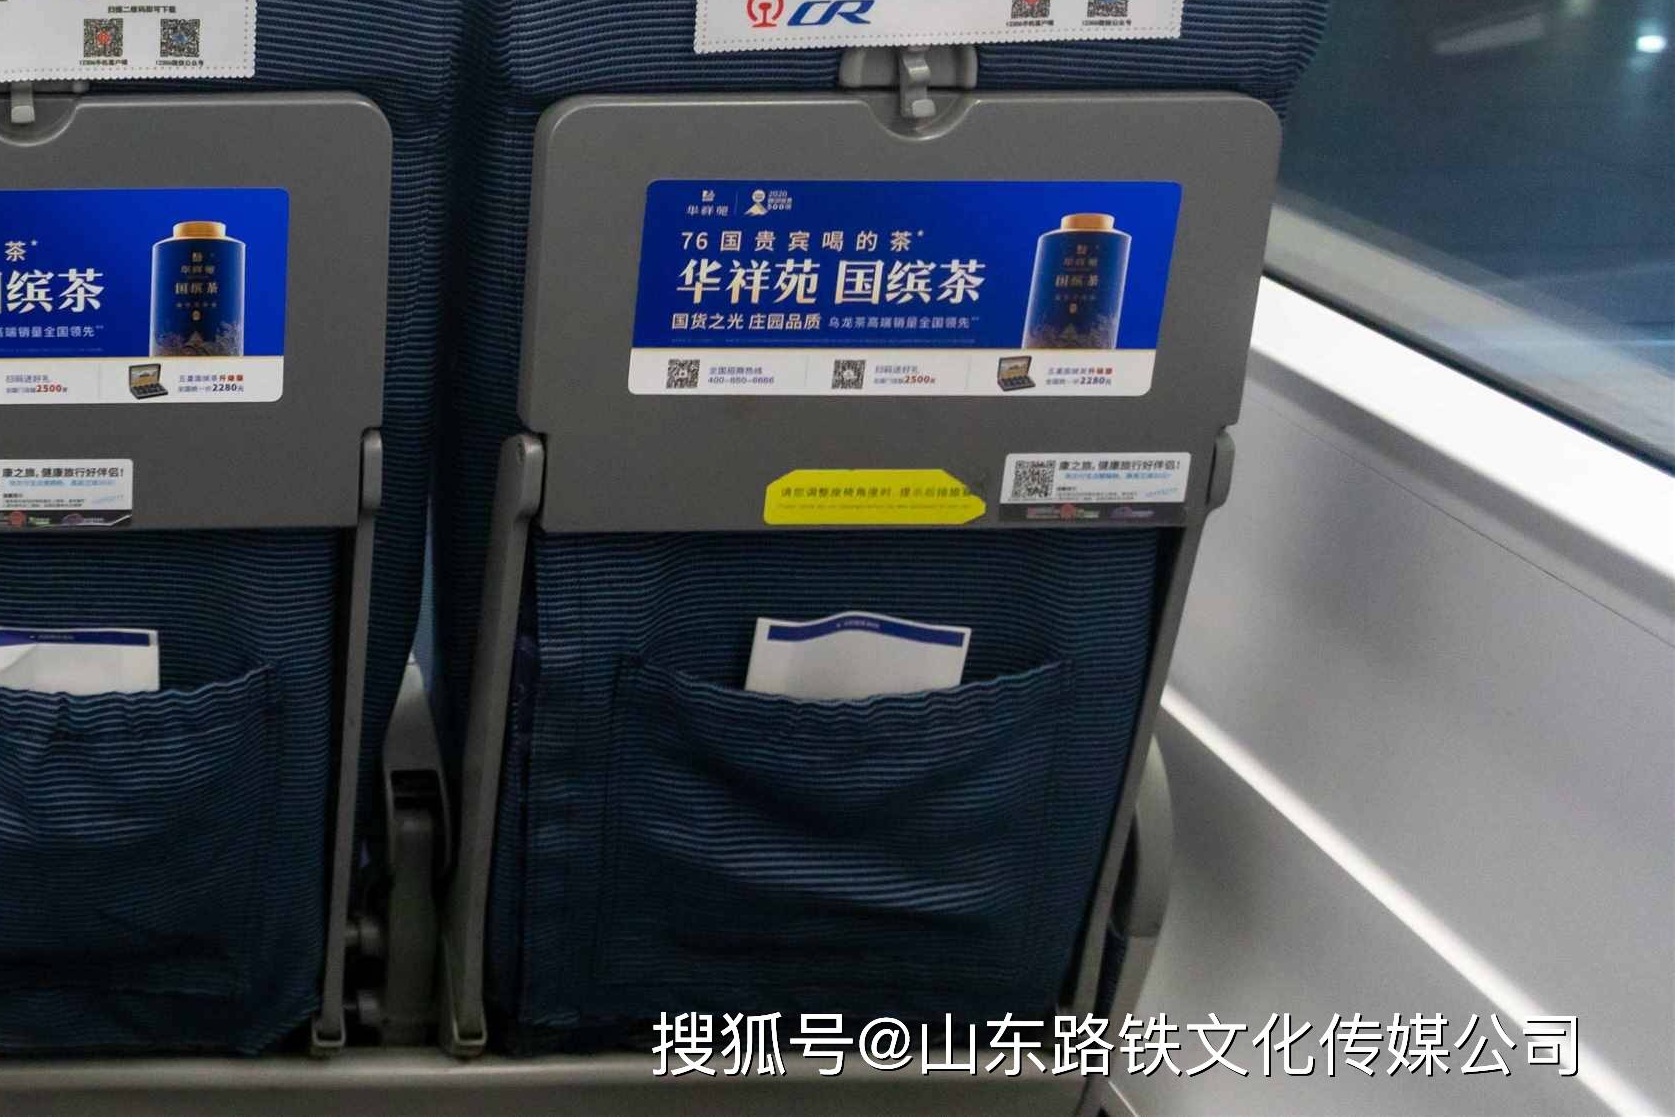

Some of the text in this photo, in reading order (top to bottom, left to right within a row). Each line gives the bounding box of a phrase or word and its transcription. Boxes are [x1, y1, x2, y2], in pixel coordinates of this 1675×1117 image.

[676, 258, 986, 305] 华祥苑 国缤茶
[671, 313, 744, 331] 国货之光
[748, 312, 822, 330] 庄园品质
